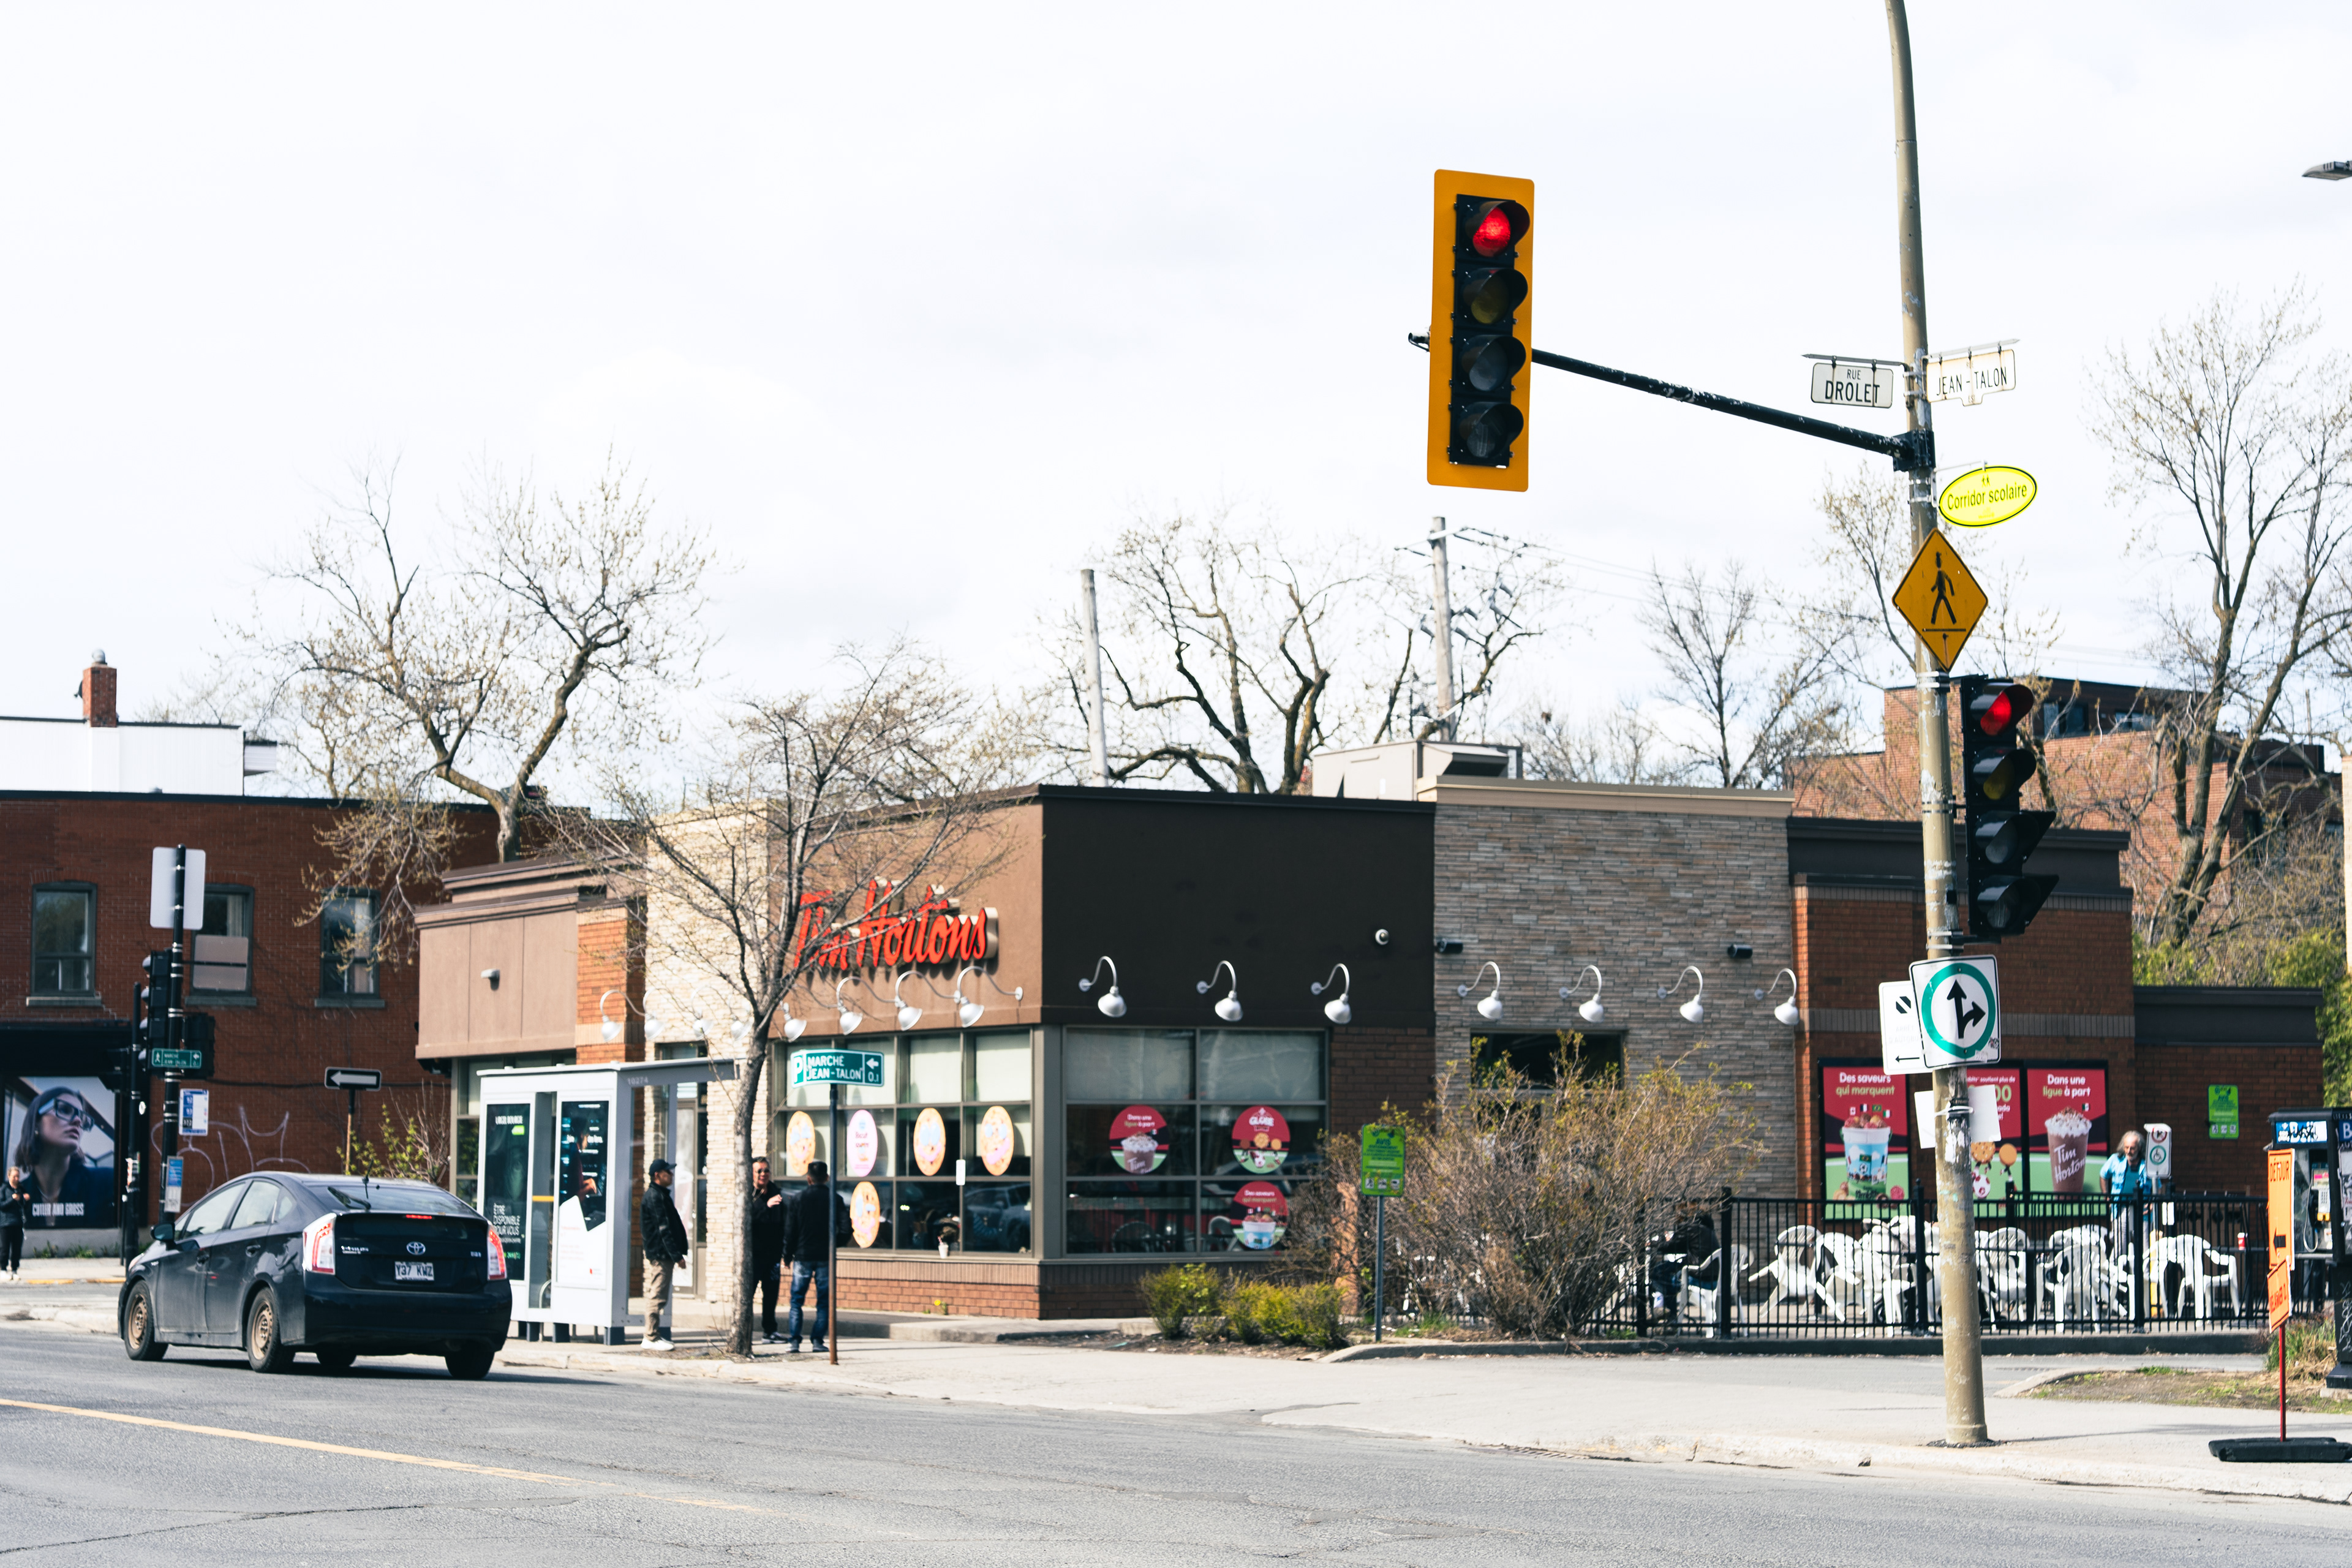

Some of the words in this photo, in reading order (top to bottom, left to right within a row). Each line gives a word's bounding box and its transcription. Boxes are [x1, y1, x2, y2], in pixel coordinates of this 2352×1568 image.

[1847, 369, 1861, 380] RUE
[1825, 380, 1880, 403] DROLET
[1948, 489, 1986, 510] Corridor
[1989, 481, 2027, 503] scolaire
[856, 878, 986, 966] Hortons
[807, 1054, 845, 1067] MARCHÉ
[1839, 1072, 1856, 1083] Des
[1858, 1074, 1891, 1083] saveurs
[2048, 1074, 2068, 1085] Dans
[2070, 1076, 2086, 1085] une
[1836, 1084, 1850, 1098] qui
[1852, 1085, 1895, 1098] marquent
[2043, 1086, 2063, 1099] ligue
[2064, 1085, 2070, 1096] à
[2071, 1087, 2091, 1099] part
[2054, 1144, 2076, 1165] Tim
[2270, 1157, 2290, 1182] DÉTOUR
[53, 1203, 64, 1216] AND
